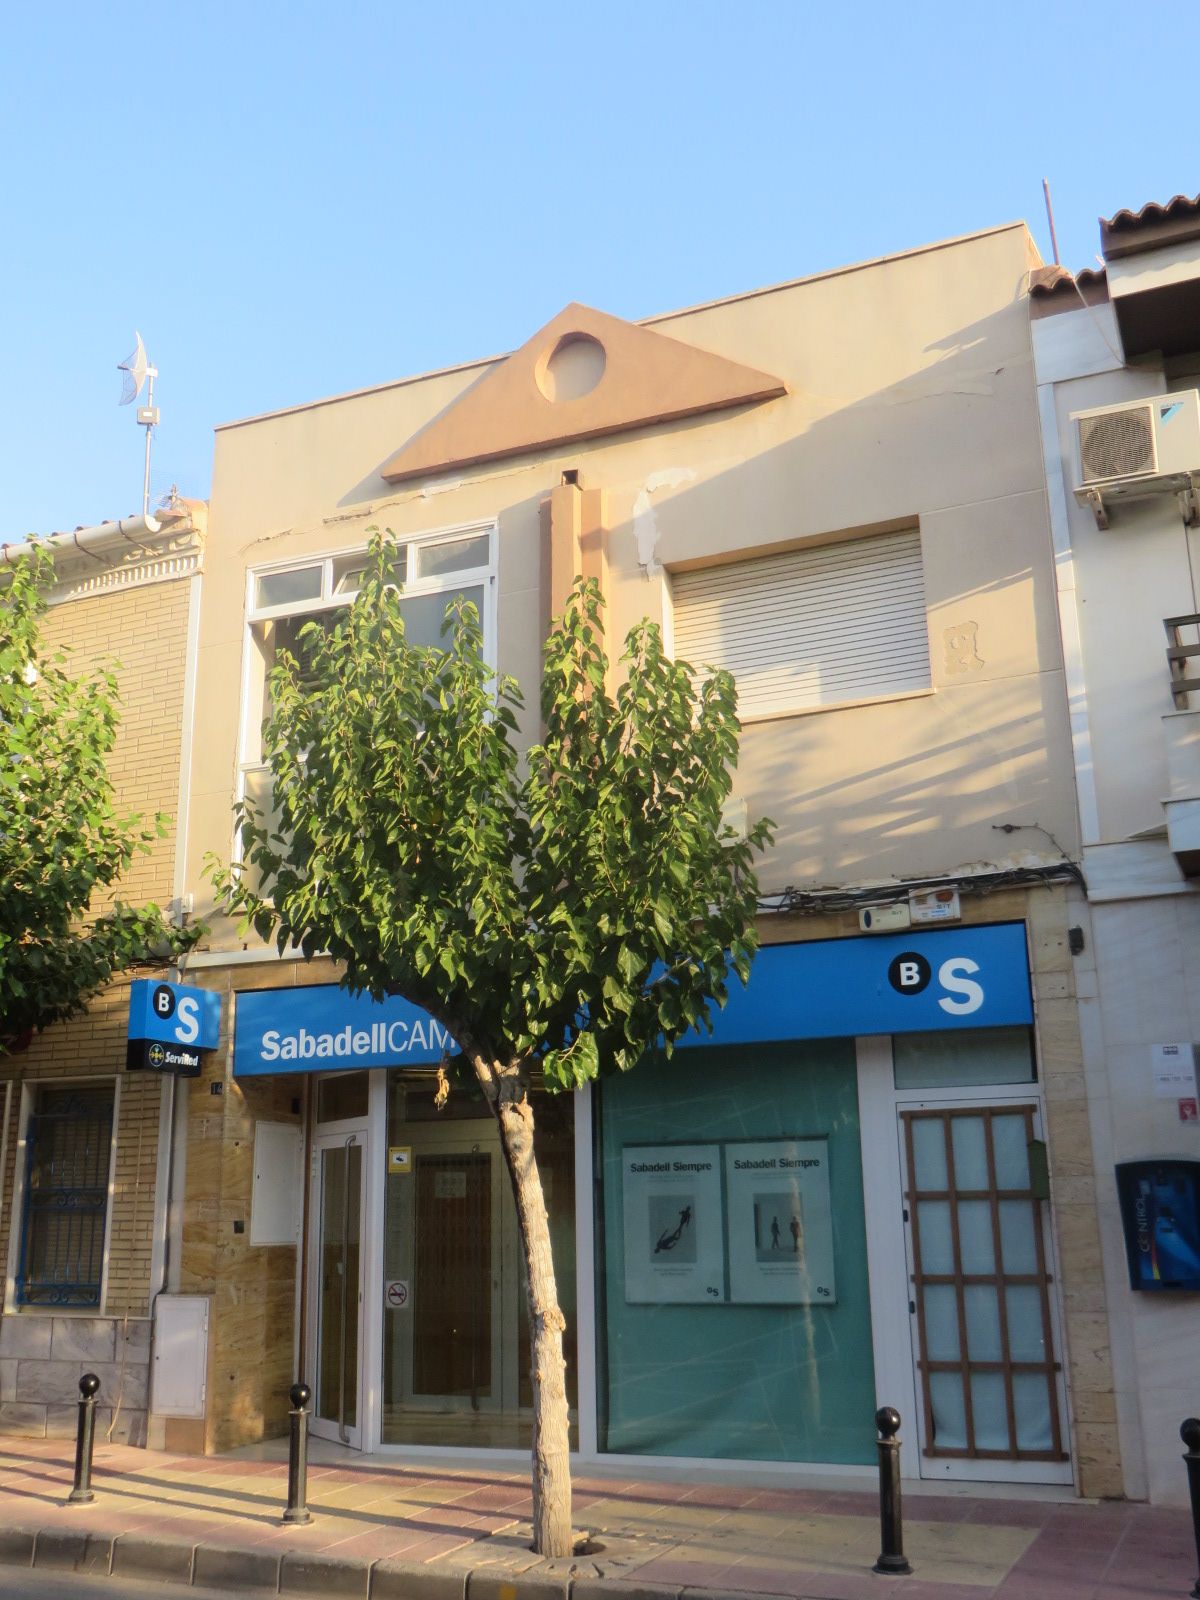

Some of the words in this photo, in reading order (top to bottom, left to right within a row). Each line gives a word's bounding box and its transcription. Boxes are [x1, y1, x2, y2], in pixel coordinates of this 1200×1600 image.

[899, 961, 920, 986] B
[938, 957, 984, 1015] S
[158, 992, 170, 1012] B
[175, 997, 200, 1044] S
[164, 1051, 199, 1067] ServiRed
[630, 1162, 670, 1173] Sabadell
[673, 1161, 712, 1173] Siempre
[733, 1158, 776, 1170] Sabadell
[778, 1157, 820, 1170] Siempre
